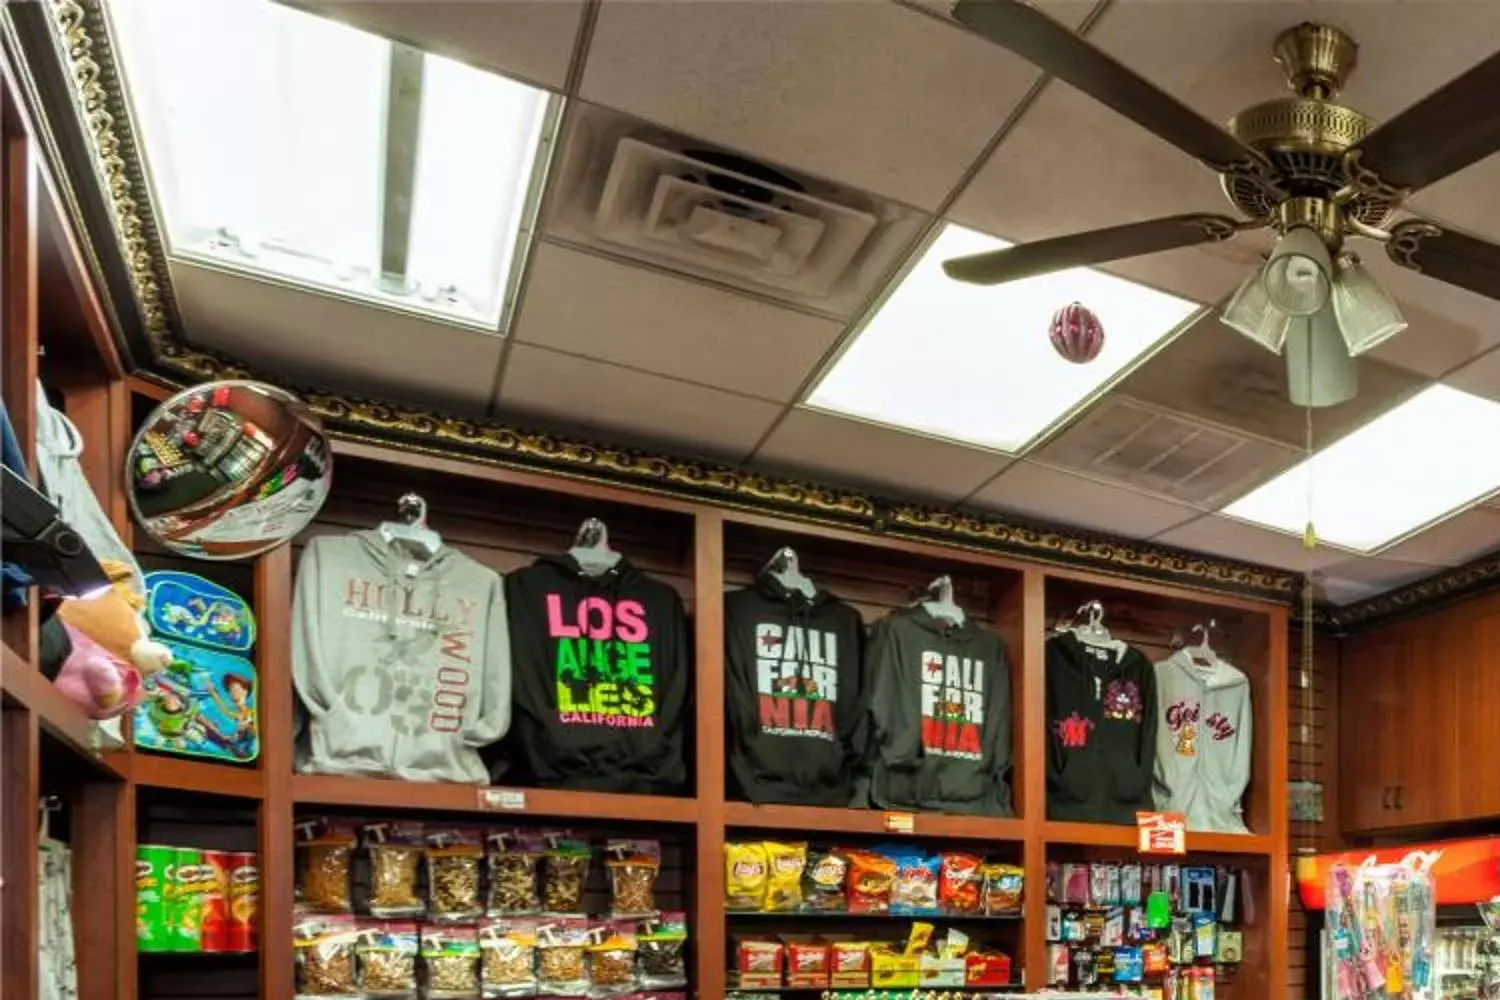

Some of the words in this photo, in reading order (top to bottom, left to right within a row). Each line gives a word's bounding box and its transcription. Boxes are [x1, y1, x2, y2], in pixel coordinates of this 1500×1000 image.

[545, 593, 649, 643] LOS
[756, 623, 837, 667] CALI
[921, 650, 984, 692] CALI
[560, 712, 655, 727] CALIFORNIA
[759, 694, 835, 734] NIA
